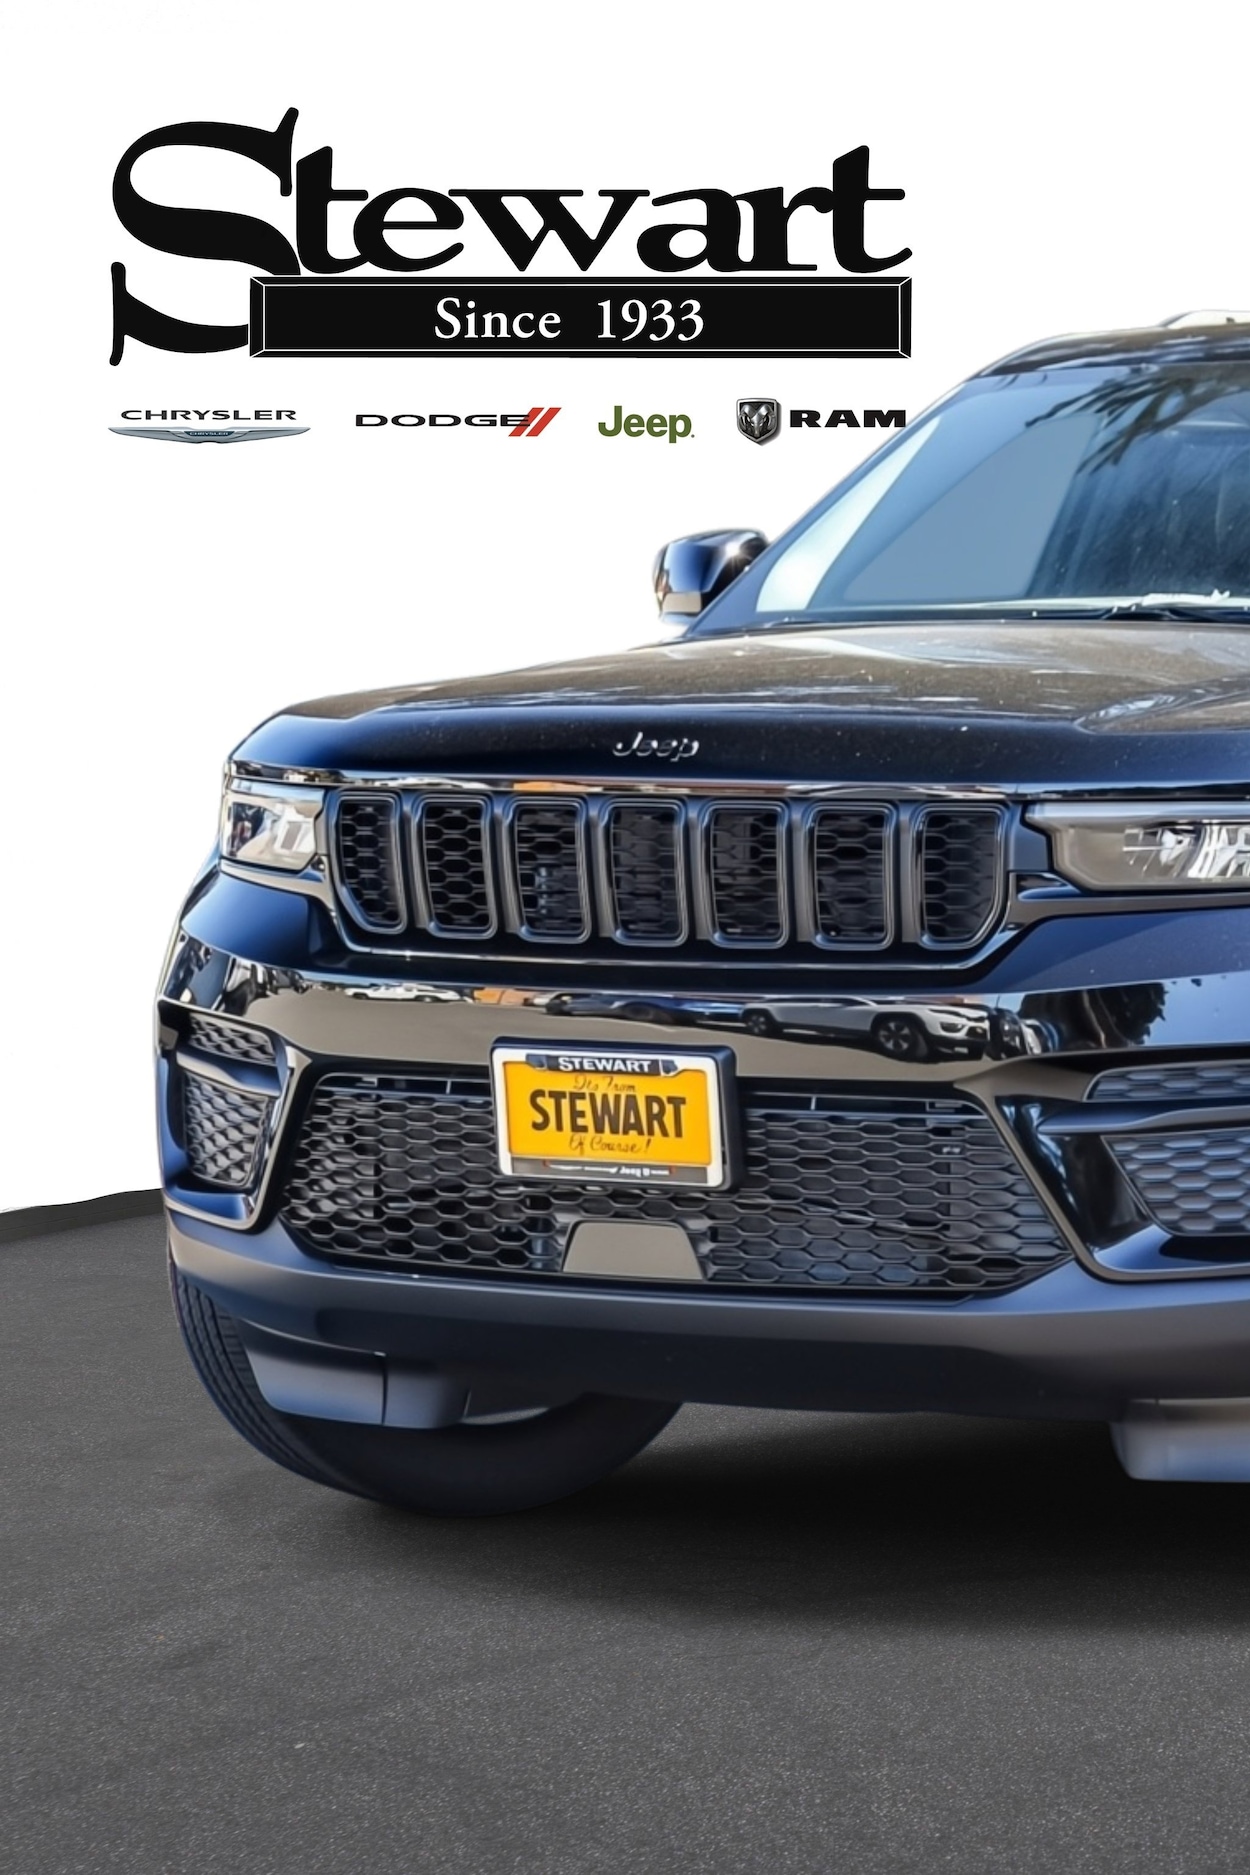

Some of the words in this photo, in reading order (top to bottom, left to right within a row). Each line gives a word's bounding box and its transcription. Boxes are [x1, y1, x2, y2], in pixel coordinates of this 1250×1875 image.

[612, 731, 700, 762] Jeep
[558, 1056, 652, 1074] STEWART
[529, 1088, 687, 1139] STEWART
